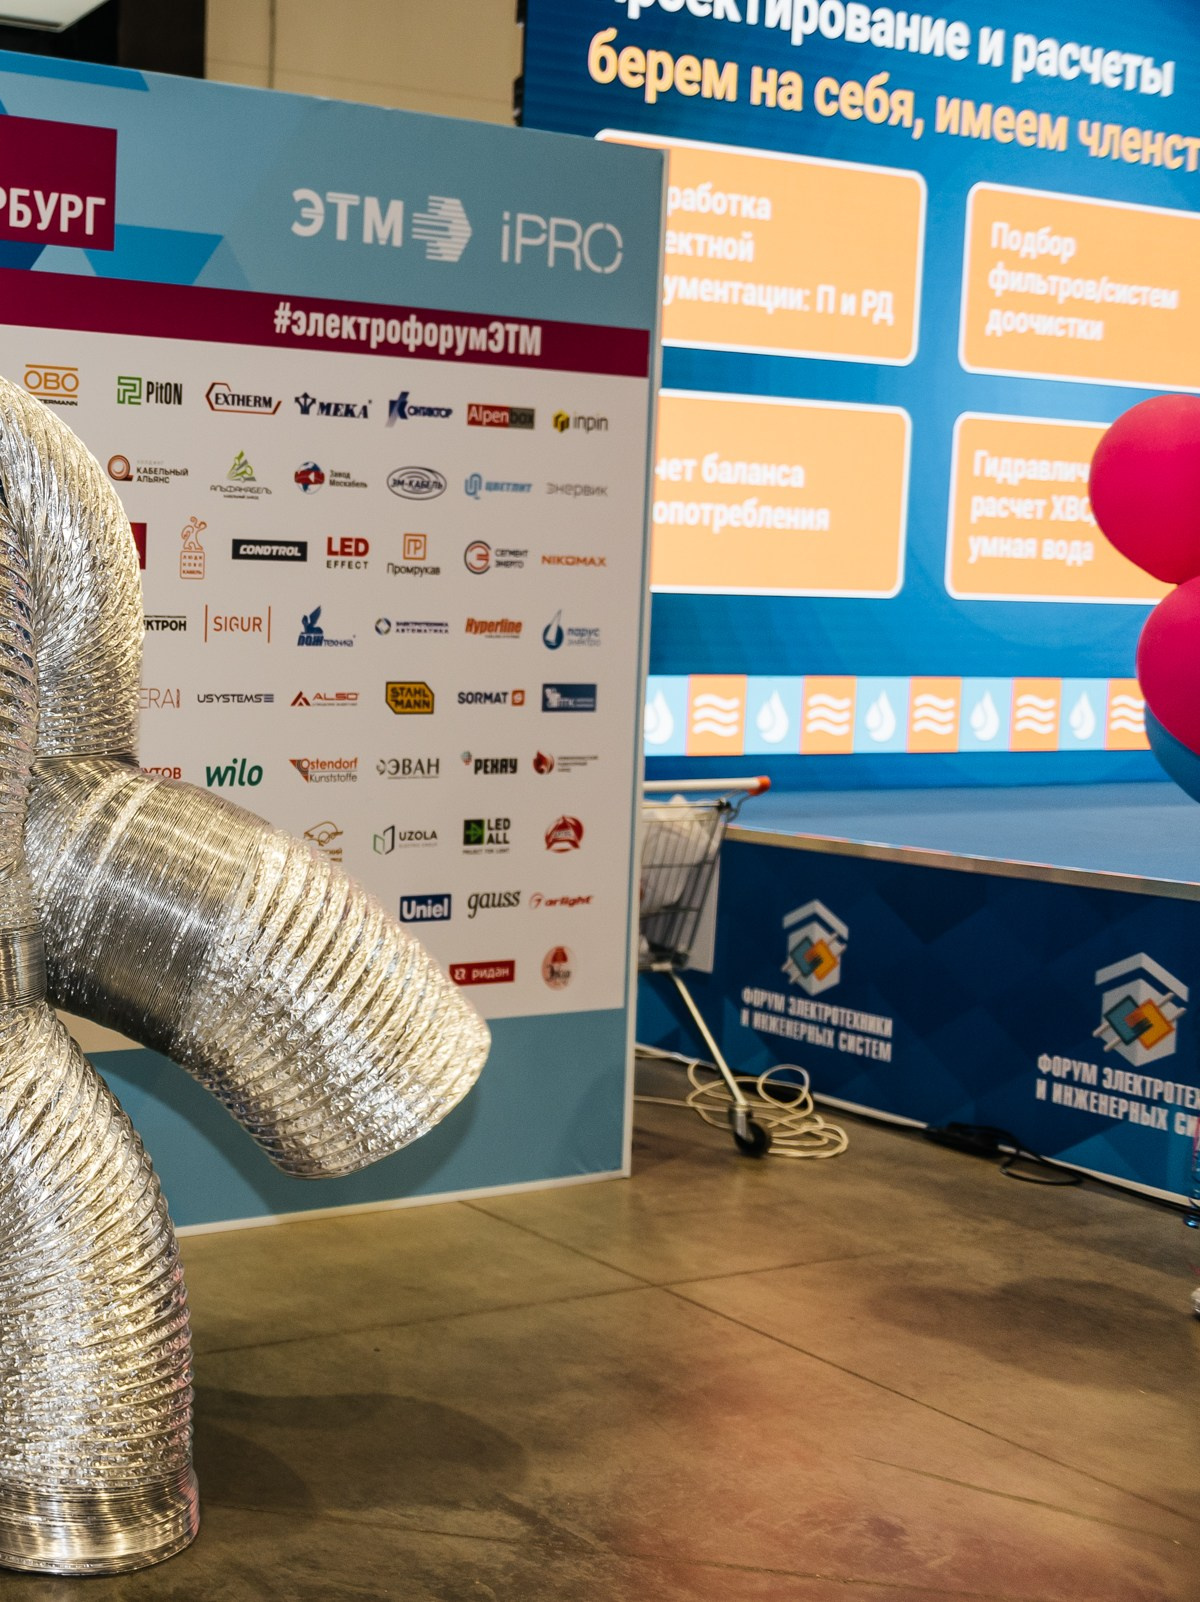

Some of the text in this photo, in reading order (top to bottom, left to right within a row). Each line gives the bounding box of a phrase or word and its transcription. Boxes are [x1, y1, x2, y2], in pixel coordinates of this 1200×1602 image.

[978, 26, 1004, 66] и
[1012, 33, 1176, 97] расчеты
[588, 27, 738, 104] берем
[750, 65, 804, 111] на
[814, 71, 923, 139] себя,
[936, 96, 1068, 151] имеем
[667, 181, 772, 220] работка
[291, 188, 404, 247] ЭТМ
[501, 211, 624, 274] iPRO
[665, 231, 754, 263] ектной
[991, 222, 1075, 263] Подбор
[663, 273, 895, 326] ументации: П и РД
[988, 262, 1179, 311] фильтров/систем
[274, 302, 542, 356] #электрофорумЭТМ
[986, 305, 1103, 341] доочистки
[24, 370, 79, 392] OBO
[214, 392, 273, 409] EXTHERM
[136, 467, 189, 476] КАБЕЛЬНЫЙ
[136, 475, 170, 484] АЛЬЯНС
[655, 452, 805, 488] чет баланса
[973, 449, 1091, 485] Гидравлич
[652, 496, 830, 535] опотребления
[970, 495, 1047, 524] расчет
[239, 544, 301, 557] CONDTROL
[327, 536, 369, 557] LED
[968, 535, 1093, 566] умная вода
[327, 560, 369, 570] EFFECT
[387, 563, 441, 577] Промрукав
[213, 616, 262, 632] SIGUR
[465, 617, 522, 634] Hyperline
[390, 686, 429, 699] STAHL
[457, 691, 508, 705] SORMAT
[206, 758, 263, 787] wilo
[302, 757, 358, 771] Ostendorf
[398, 831, 438, 841] UZOLA
[487, 818, 511, 831] LED
[487, 832, 510, 845] ALL
[402, 899, 449, 920] Uniel
[468, 891, 520, 919] gauss
[741, 987, 893, 1038] ФОРУМ ЭЛЕКТРОТЕХНИКИ
[741, 1009, 892, 1063] И ИНЖЕНЕРНЫХ СИСТЕМ
[1037, 1053, 1098, 1086] ФОРУМ
[1036, 1078, 1047, 1100] И
[1052, 1082, 1169, 1131] ИНЖЕНЕРНЫХ
